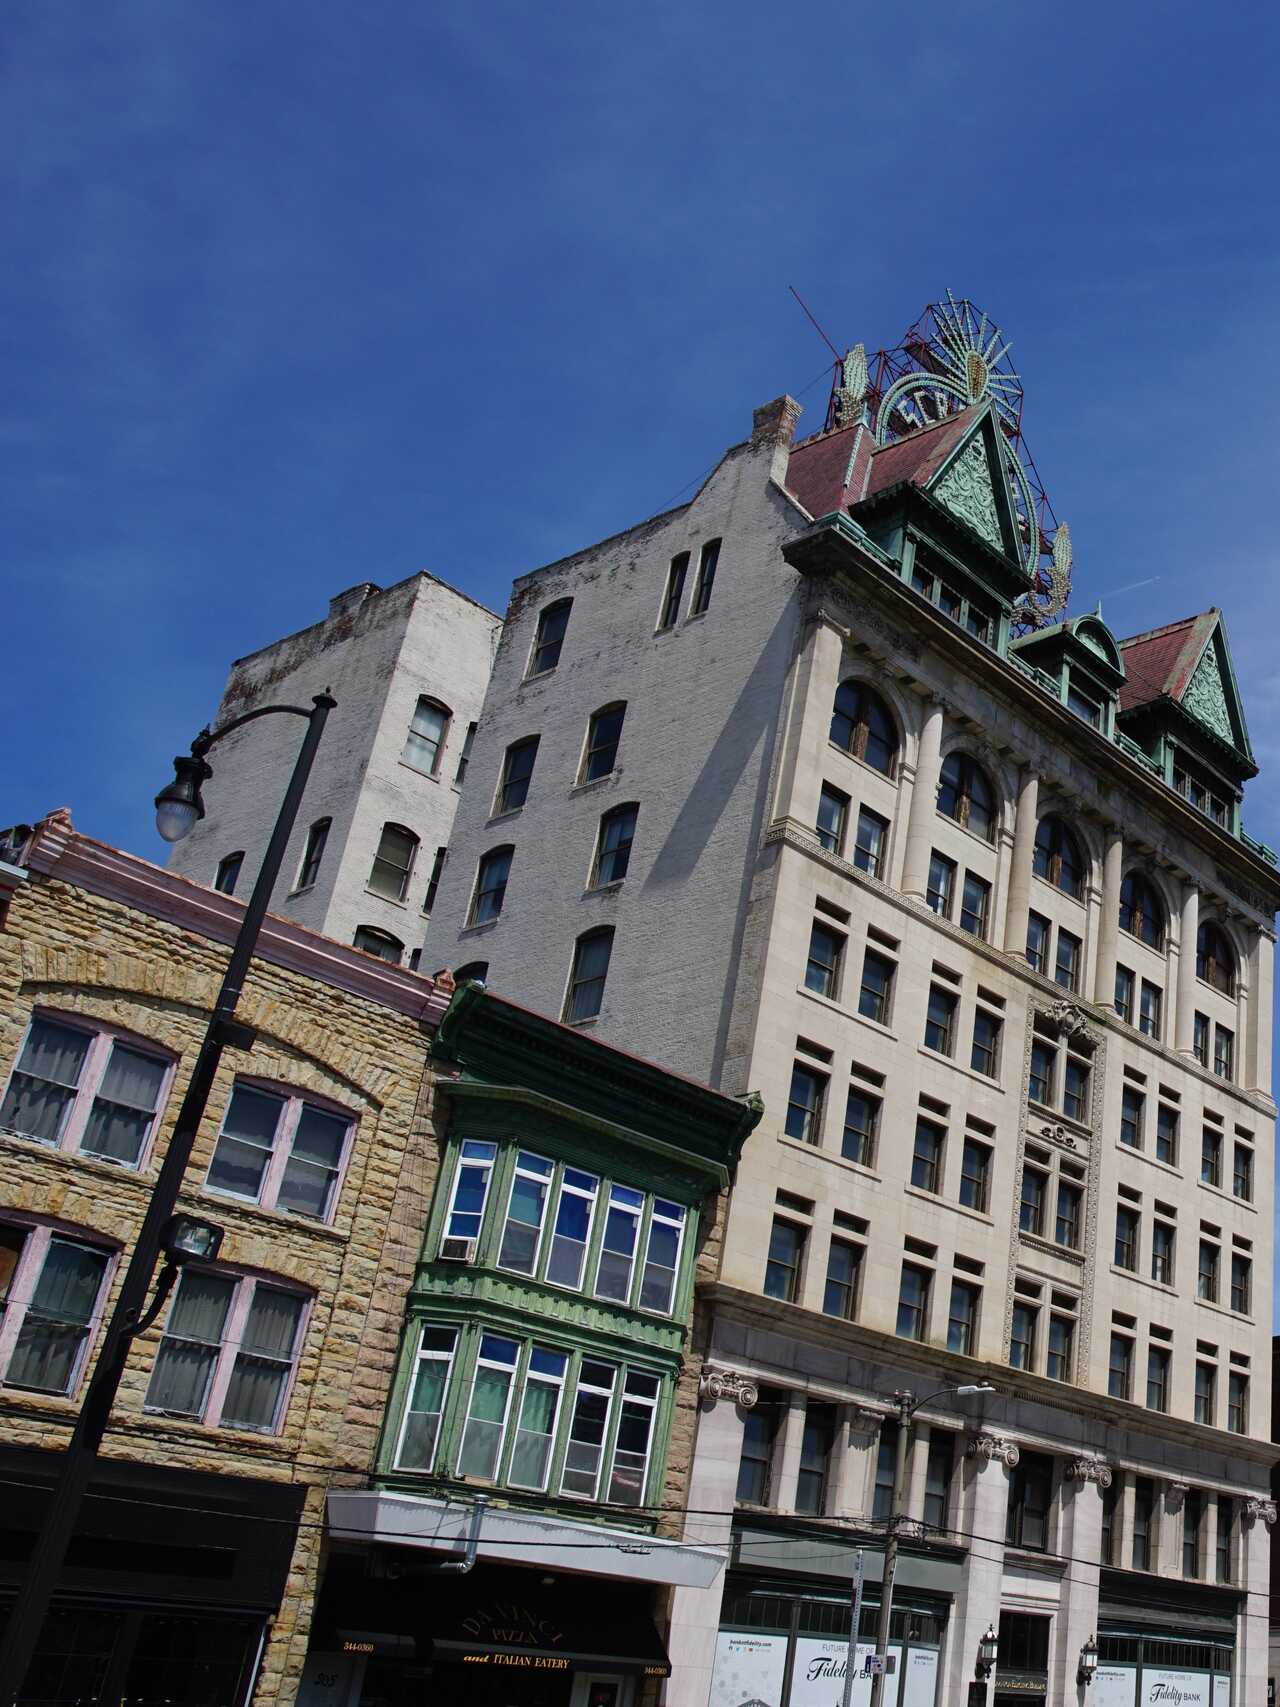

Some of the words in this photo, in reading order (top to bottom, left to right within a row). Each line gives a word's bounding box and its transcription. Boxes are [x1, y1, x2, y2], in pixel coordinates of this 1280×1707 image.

[463, 1654, 489, 1663] and
[493, 1654, 531, 1666] ITALIAN
[534, 1656, 570, 1670] EATERY
[1150, 1682, 1184, 1706] Fidelity
[1183, 1692, 1201, 1702] BANK
